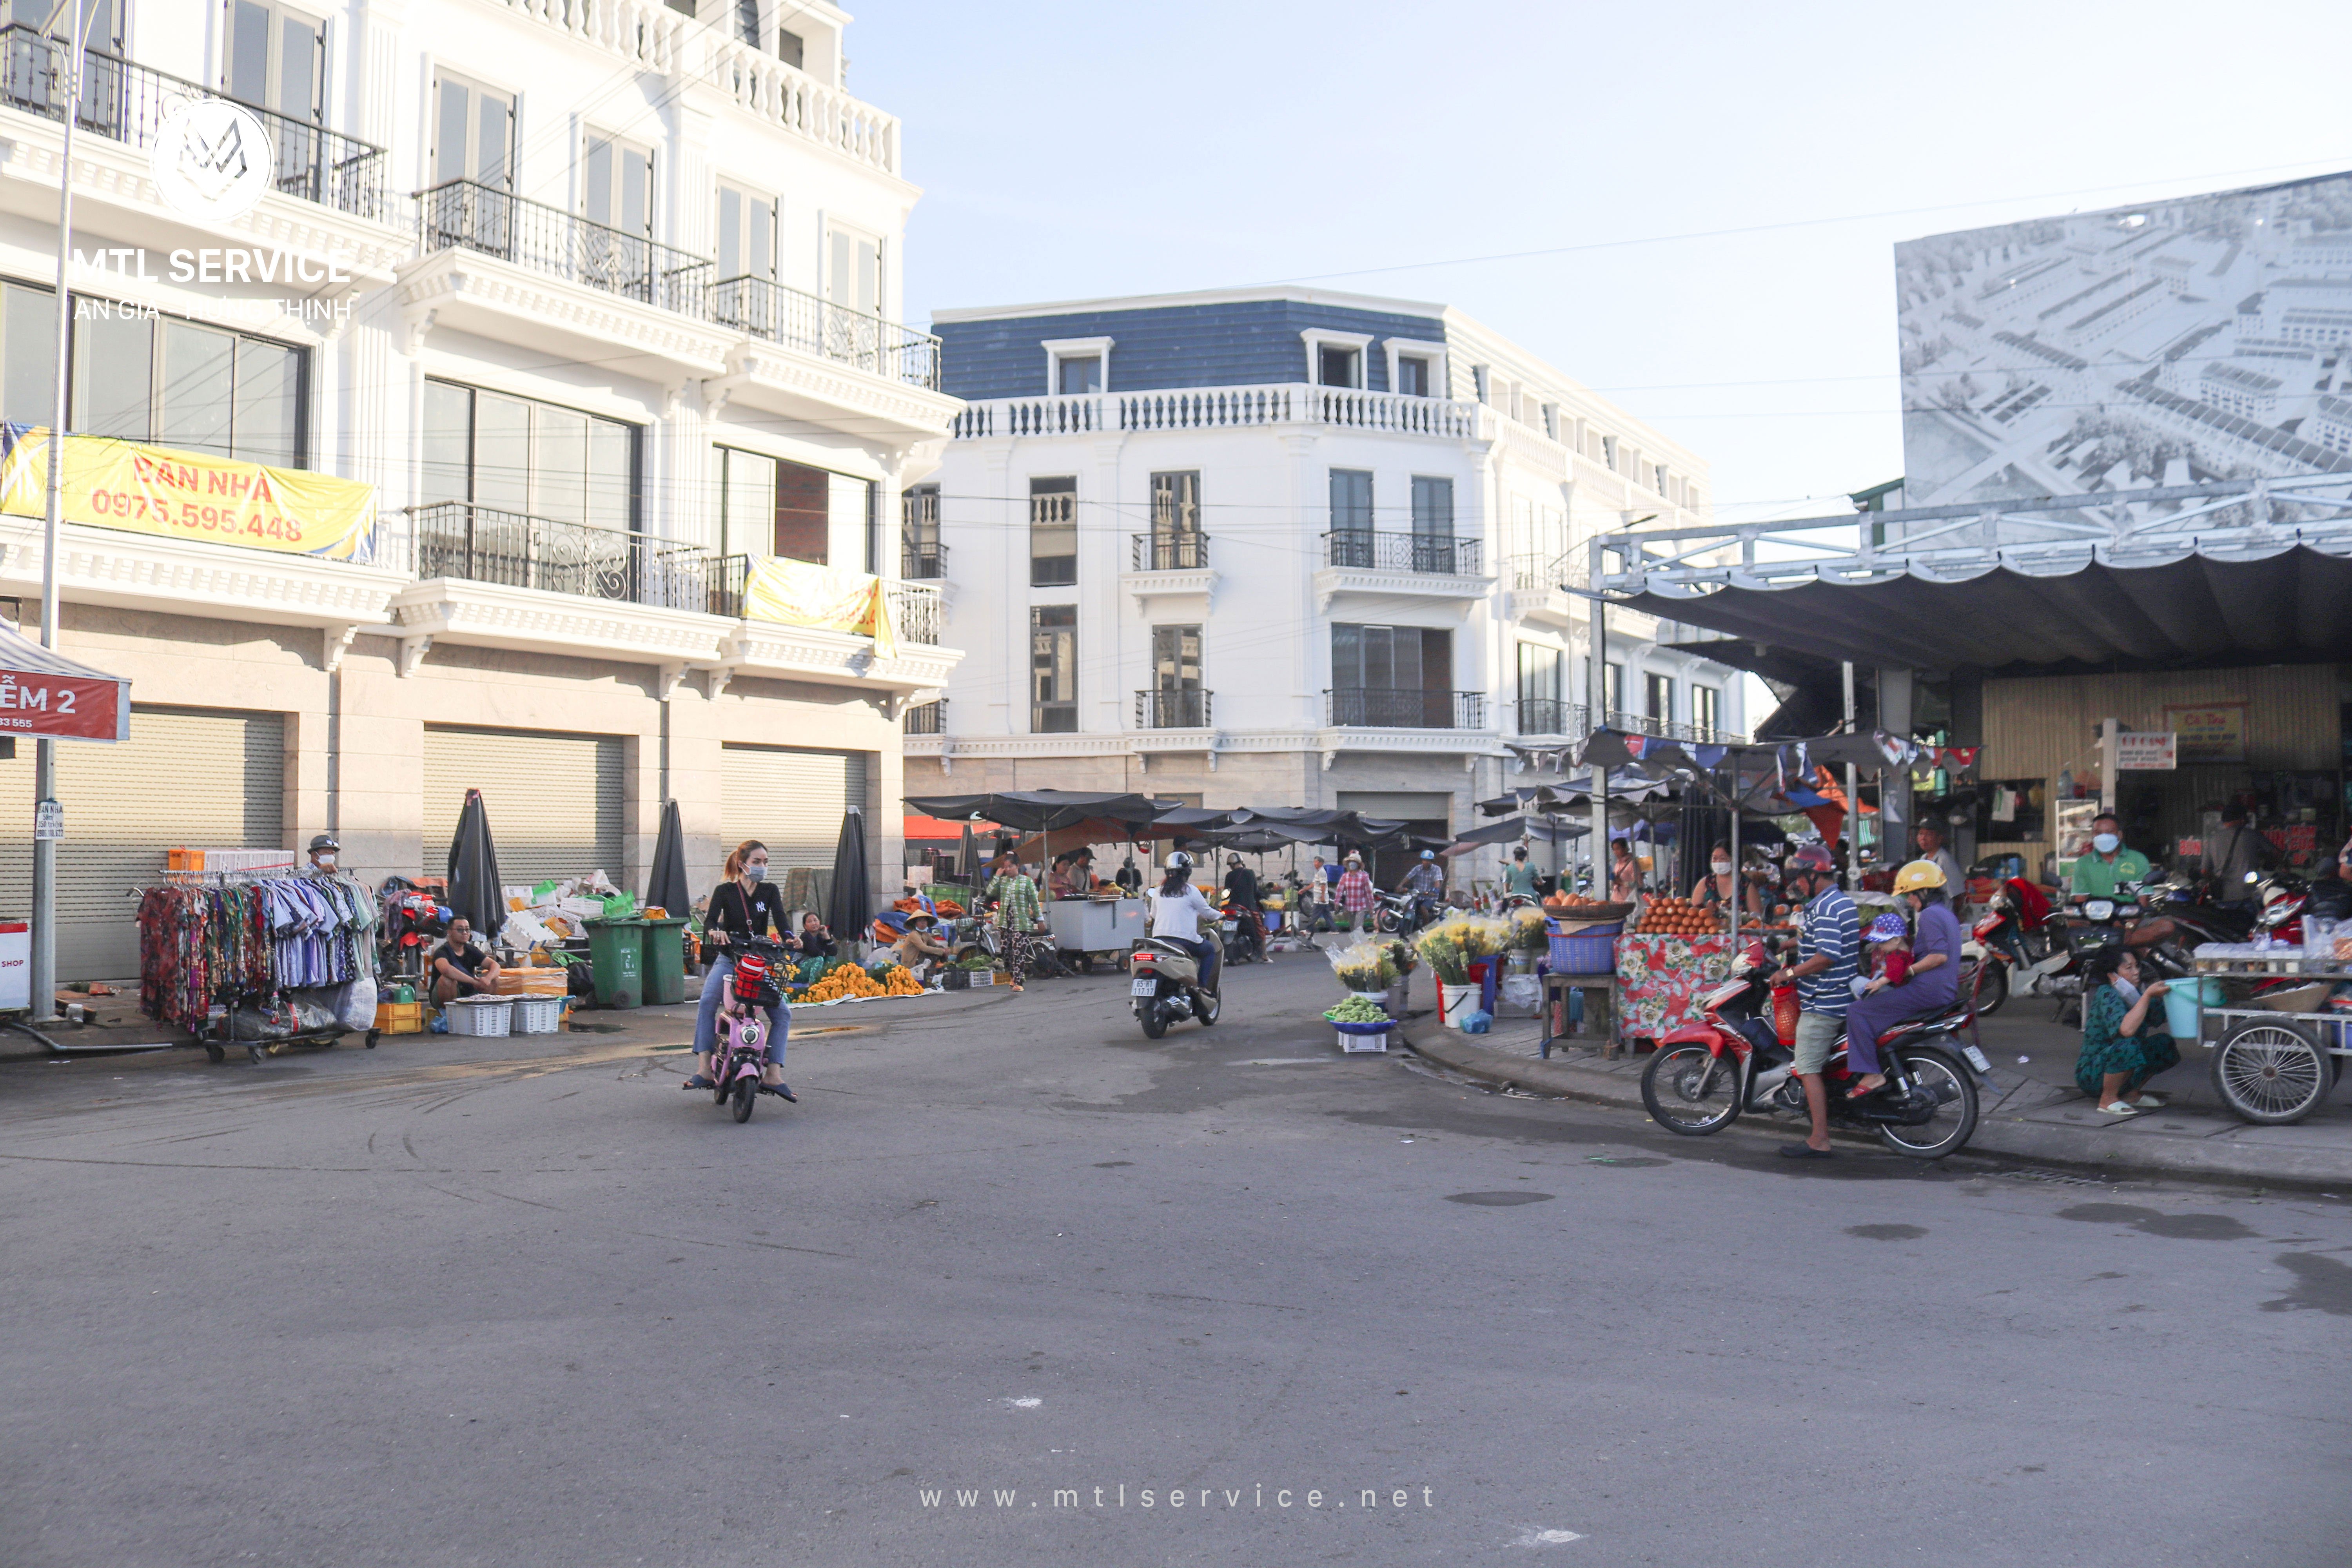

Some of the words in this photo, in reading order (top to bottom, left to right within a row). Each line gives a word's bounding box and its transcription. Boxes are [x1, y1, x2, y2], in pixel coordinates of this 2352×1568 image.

[134, 457, 198, 492] BÁN
[93, 489, 302, 542] 0975.595.448
[57, 690, 76, 714] 2
[12, 718, 33, 728] 555
